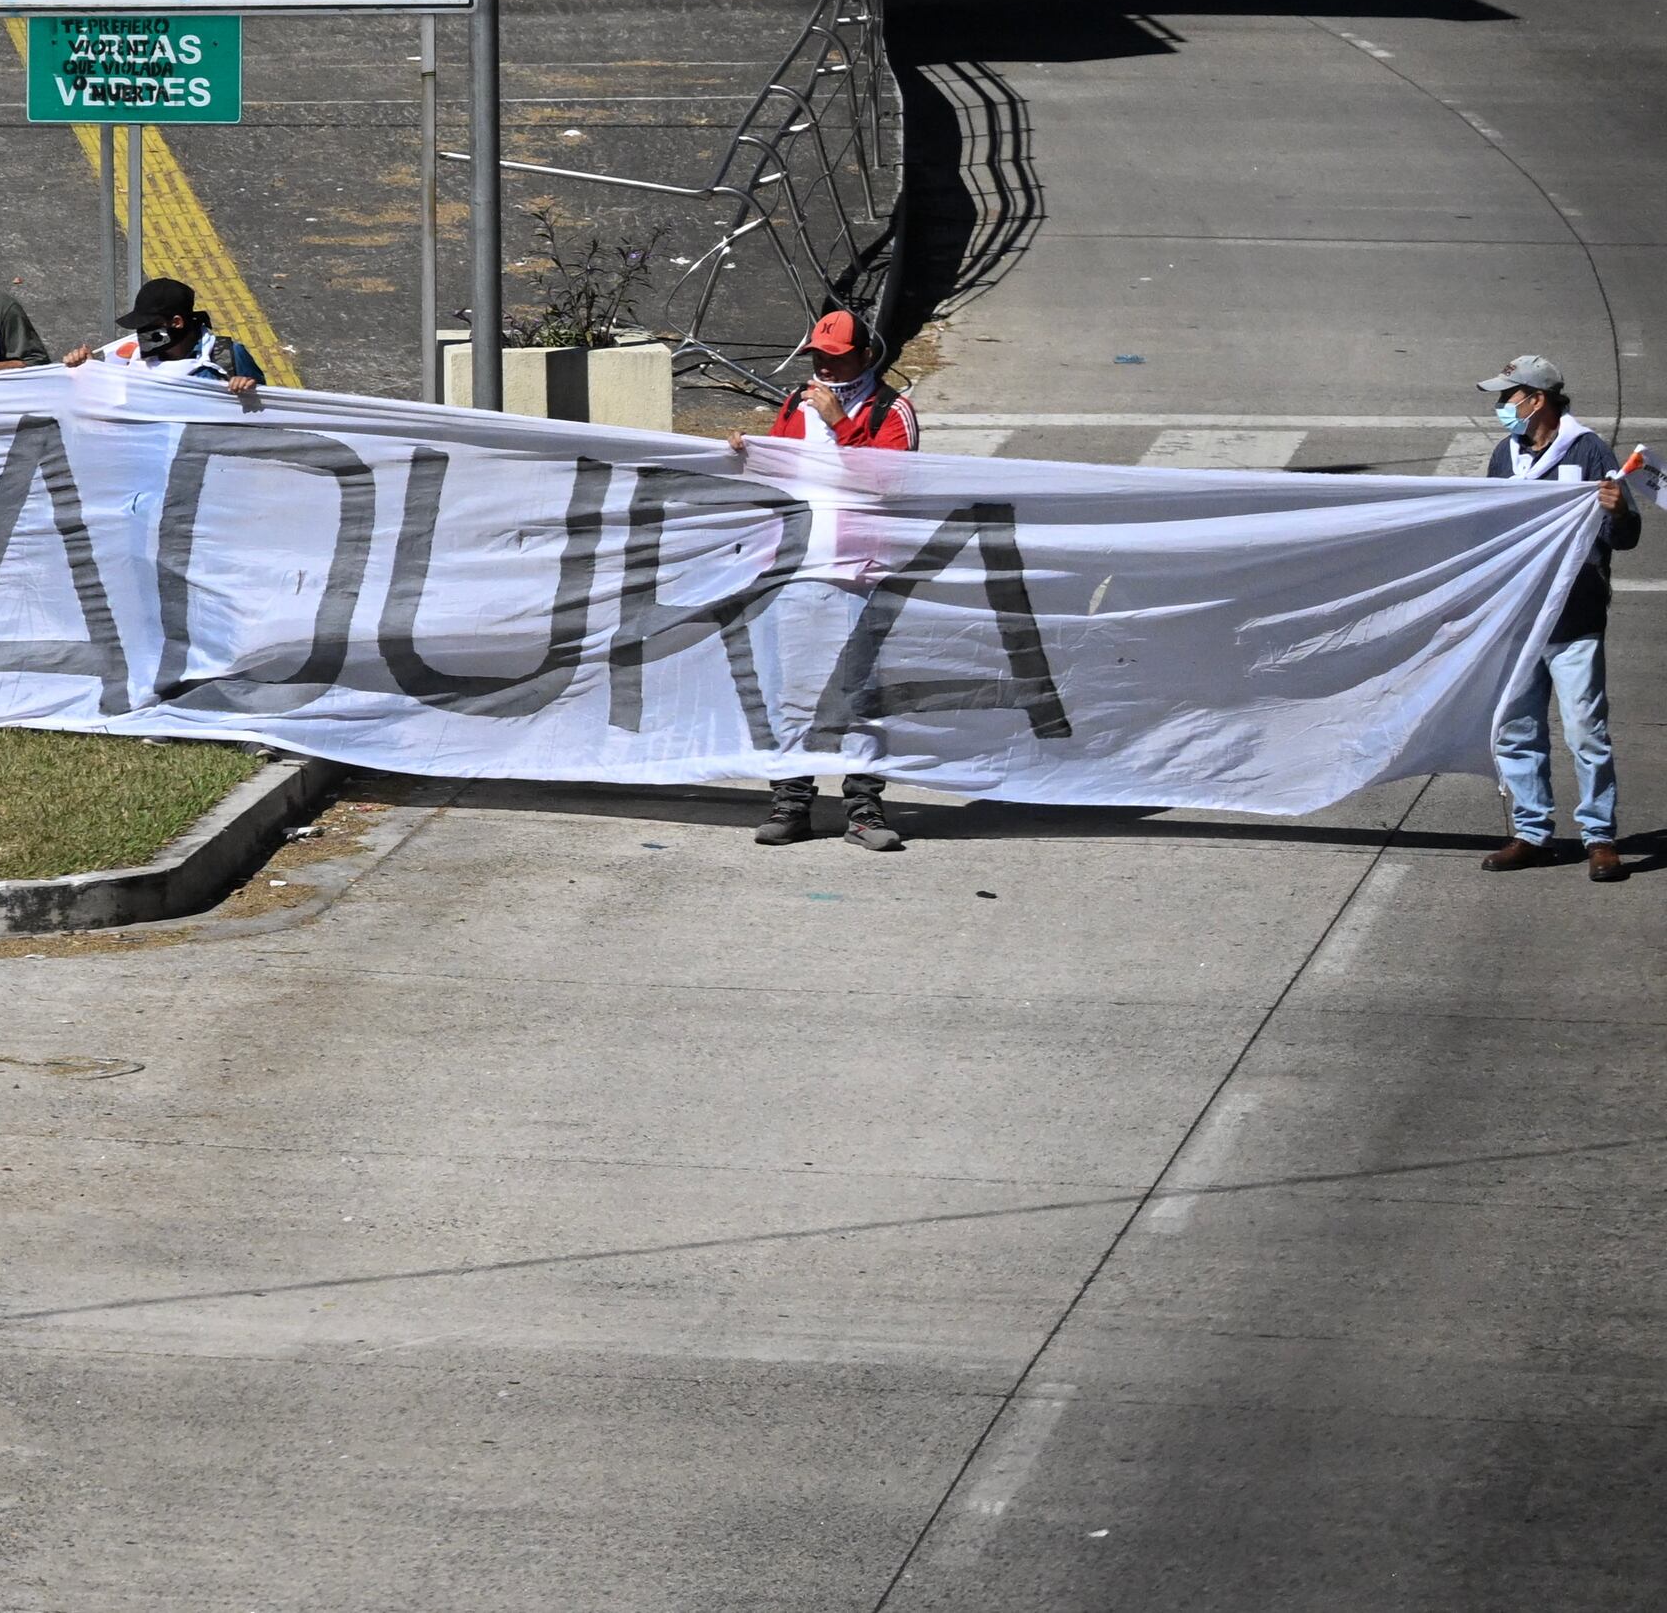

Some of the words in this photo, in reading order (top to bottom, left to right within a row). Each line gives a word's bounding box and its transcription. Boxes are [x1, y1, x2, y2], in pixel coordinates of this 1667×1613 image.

[62, 60, 97, 76] QUE
[101, 61, 175, 77] VIOLADA
[54, 76, 212, 107] VERDES
